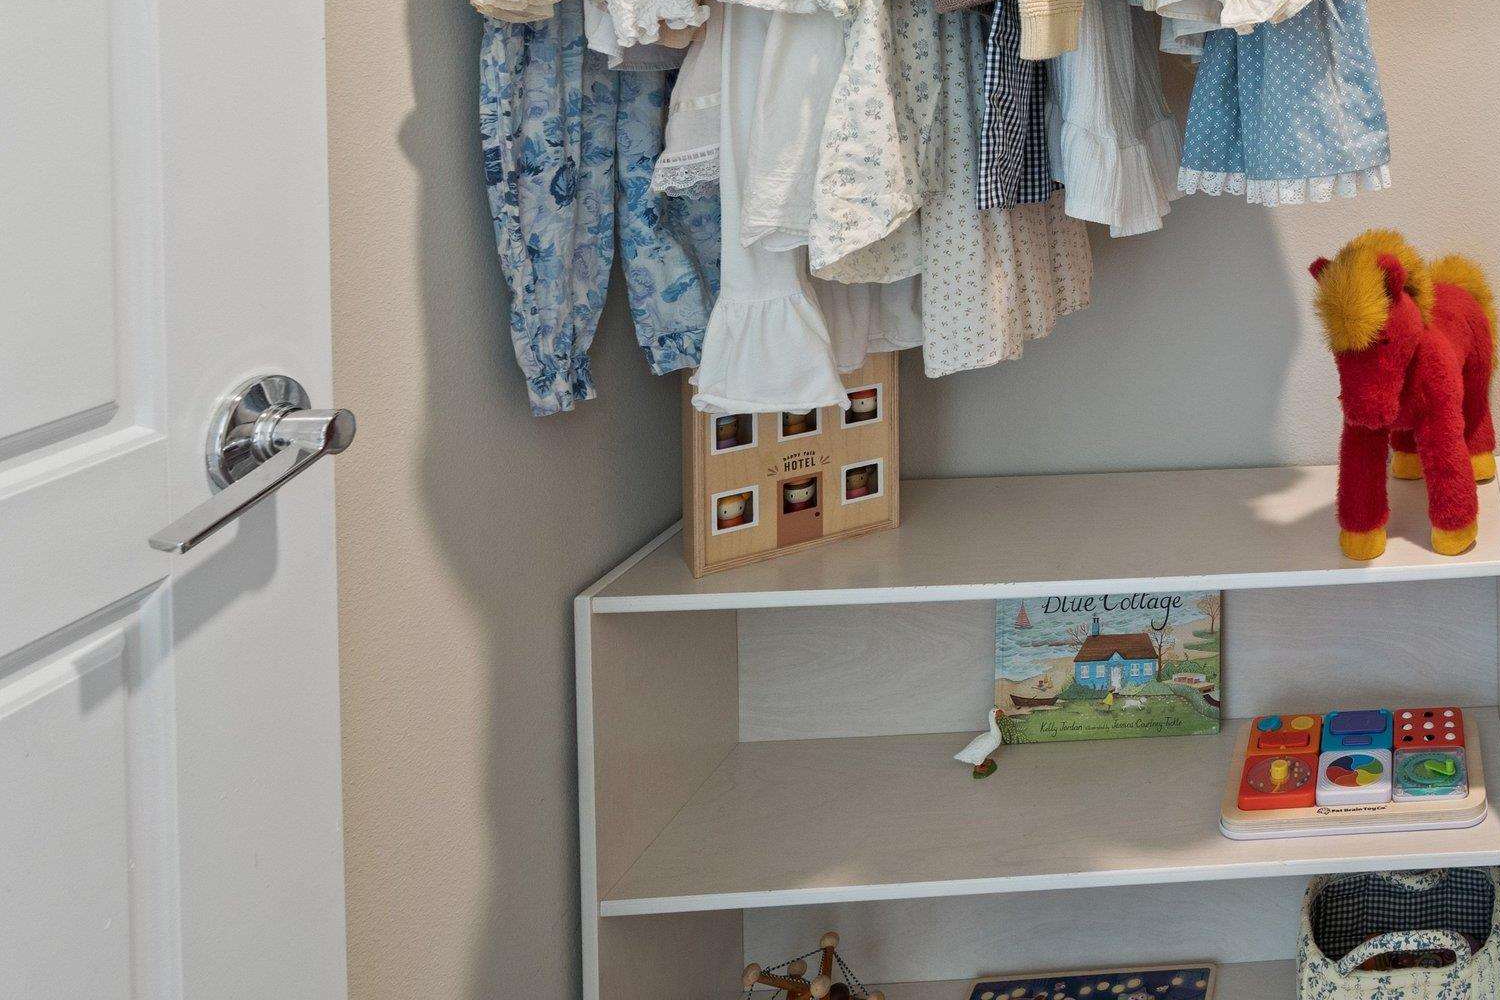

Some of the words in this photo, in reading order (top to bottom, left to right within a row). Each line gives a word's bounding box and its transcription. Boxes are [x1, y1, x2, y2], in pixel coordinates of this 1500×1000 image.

[784, 457, 816, 472] HOTEL
[1040, 721, 1058, 737] Kelly
[1059, 720, 1083, 732] Jordan
